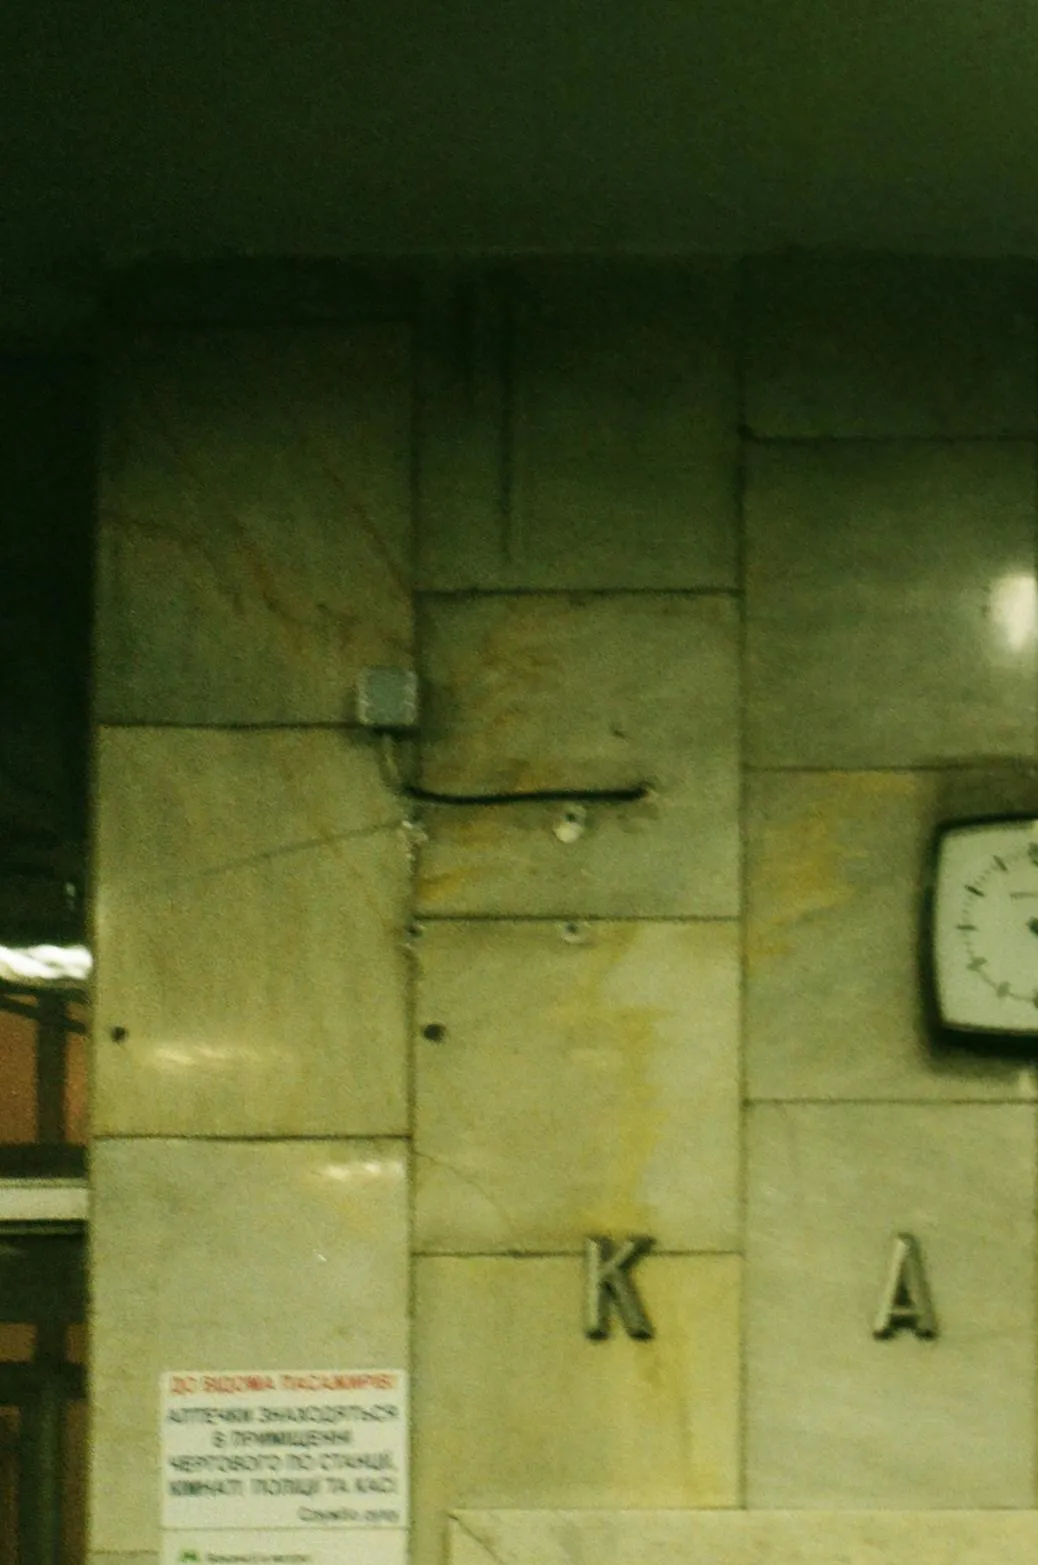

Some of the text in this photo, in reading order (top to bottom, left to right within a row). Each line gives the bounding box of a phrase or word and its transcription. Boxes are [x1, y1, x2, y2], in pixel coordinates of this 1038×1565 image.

[167, 1404, 399, 1424] АПТЕЧКИ ЗНАХОДЯТЬСЯ
[168, 1454, 281, 1473] ЧЕРГОВОГО
[286, 1453, 315, 1471] ПО
[325, 1477, 350, 1494] ТА
